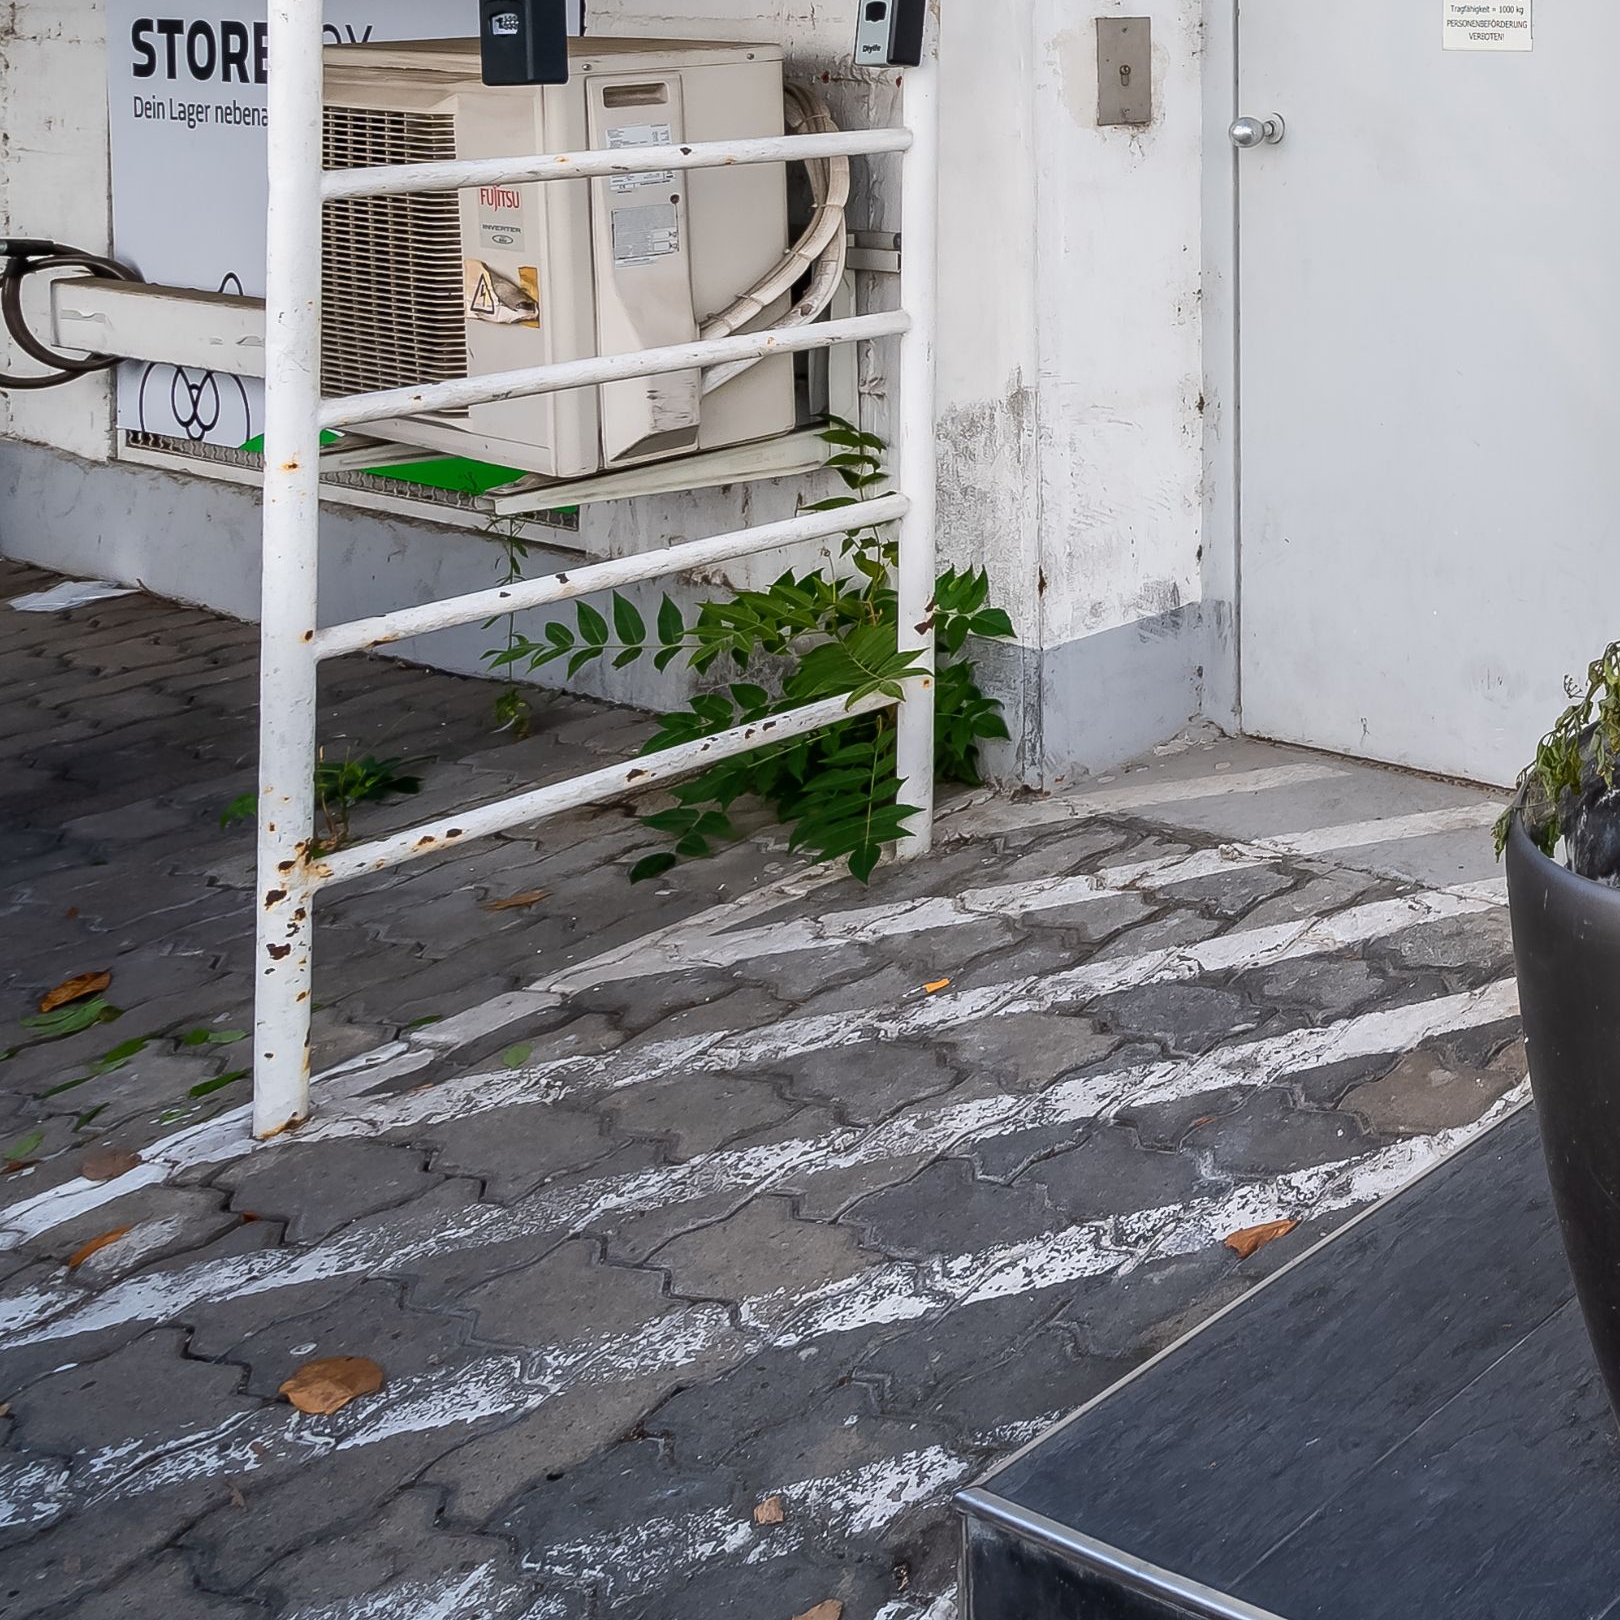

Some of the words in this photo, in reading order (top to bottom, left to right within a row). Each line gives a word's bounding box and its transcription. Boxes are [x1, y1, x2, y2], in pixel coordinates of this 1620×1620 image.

[1499, 5, 1514, 13] 1000
[1516, 6, 1524, 15] kg
[134, 94, 165, 119] Dein
[169, 97, 210, 129] Lager
[215, 101, 268, 127] nebena
[480, 184, 520, 212] FUJITSU
